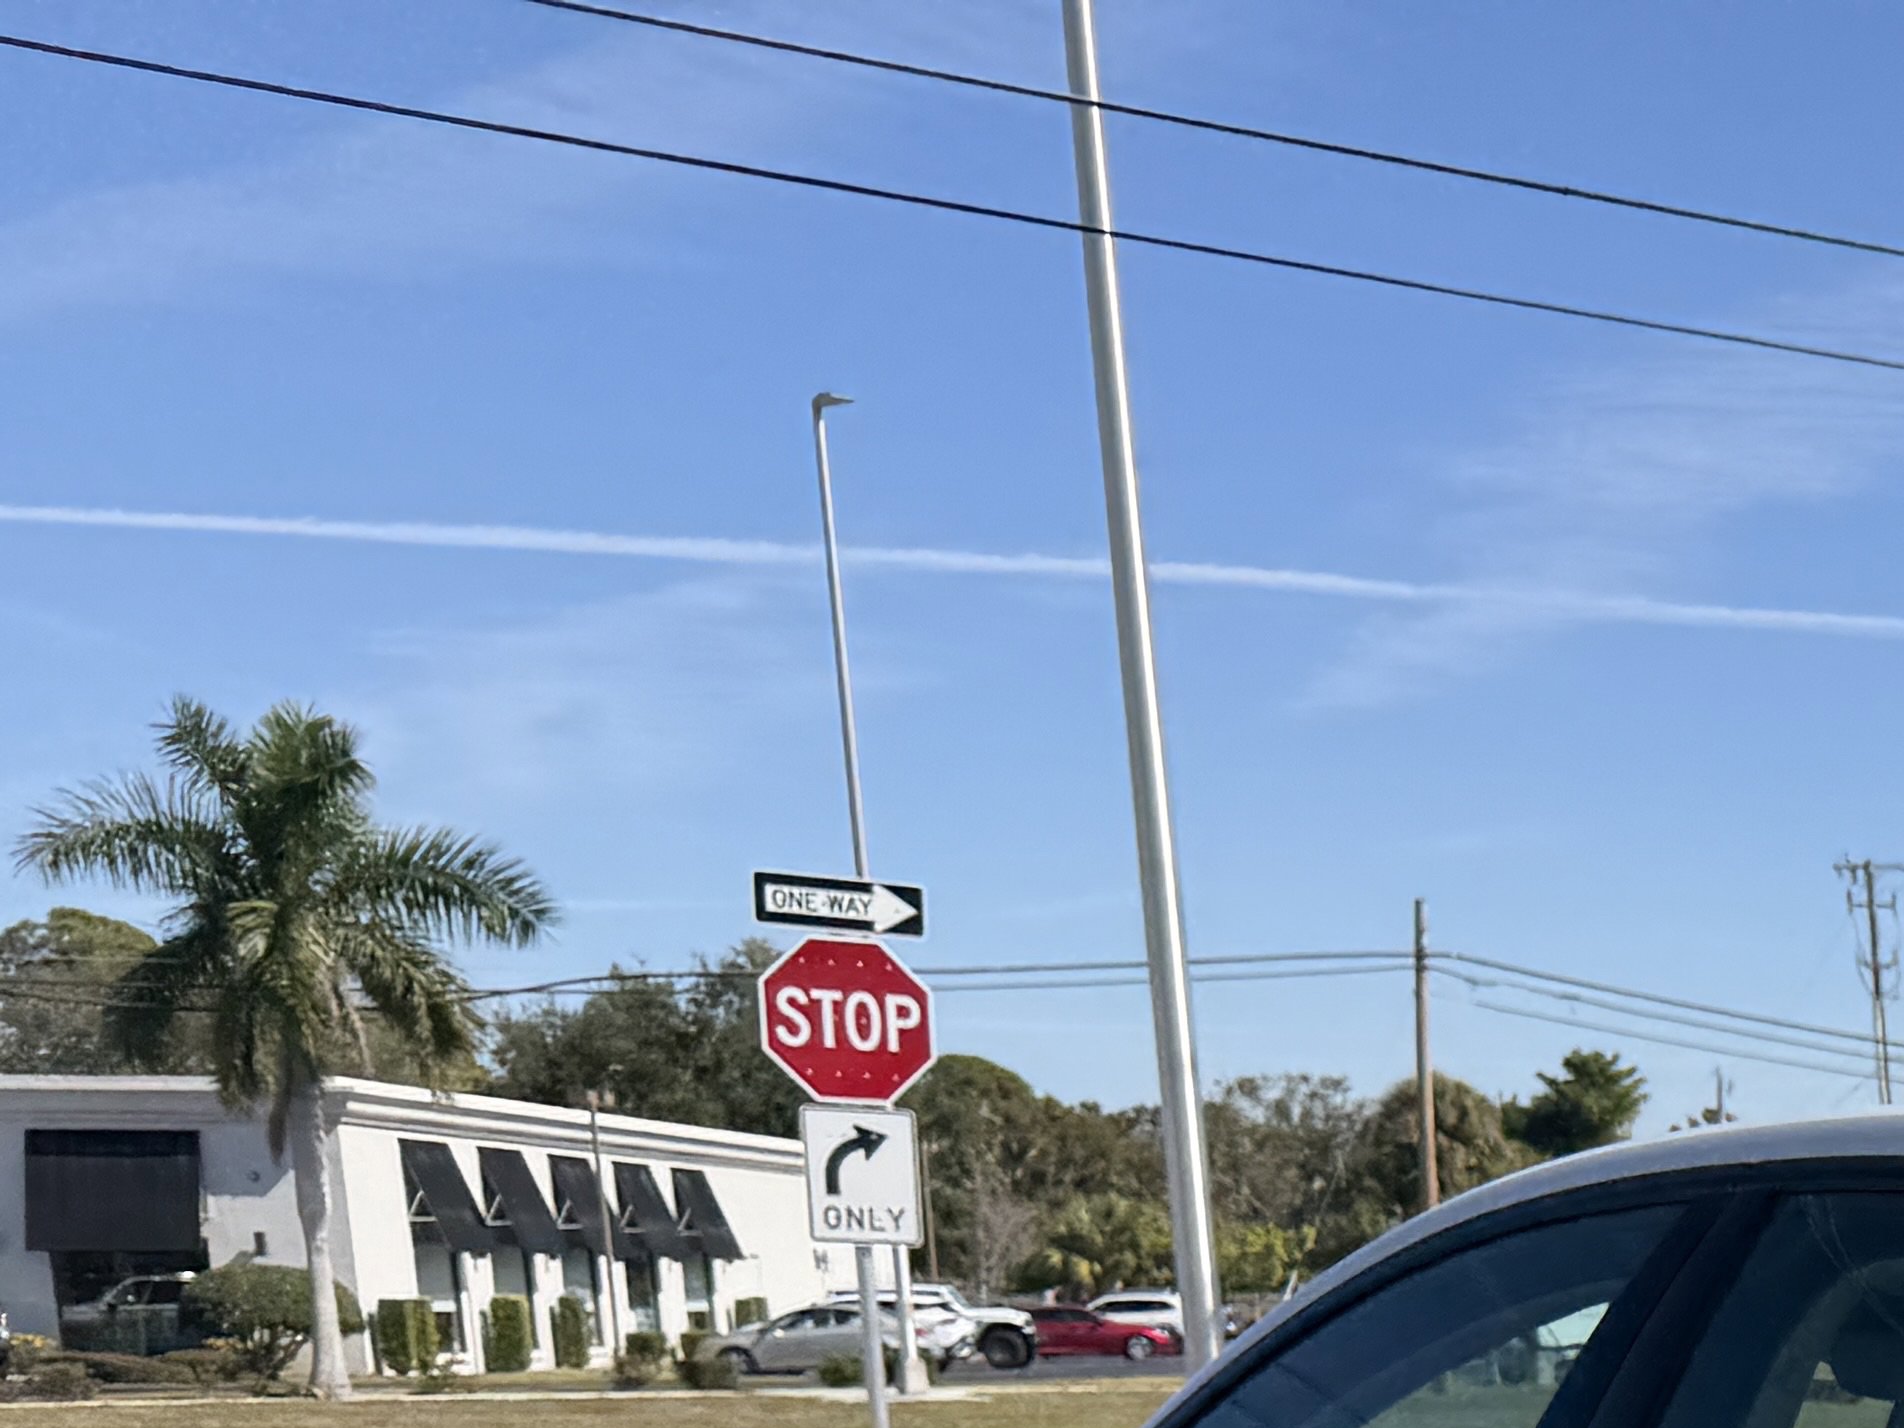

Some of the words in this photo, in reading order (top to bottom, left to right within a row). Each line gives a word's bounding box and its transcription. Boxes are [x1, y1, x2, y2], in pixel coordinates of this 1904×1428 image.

[772, 888, 817, 912] ONE
[827, 894, 873, 916] WAY
[774, 985, 922, 1053] STOP
[823, 1204, 905, 1232] ONLY
